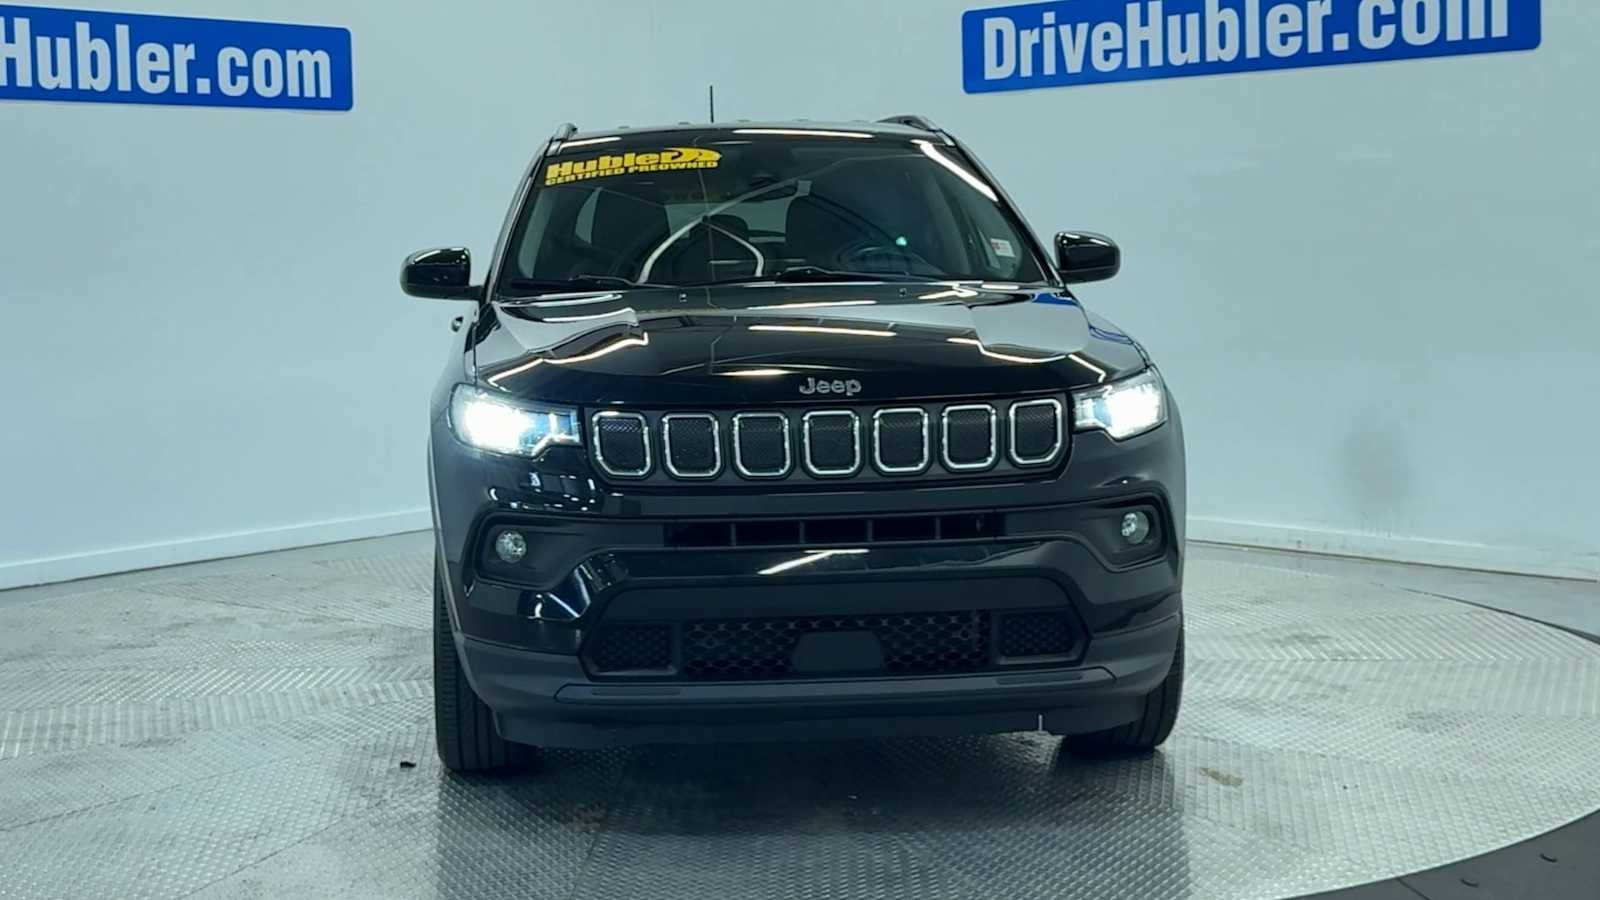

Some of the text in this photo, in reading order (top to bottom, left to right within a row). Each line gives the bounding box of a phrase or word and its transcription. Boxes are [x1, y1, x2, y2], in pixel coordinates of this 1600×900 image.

[984, 0, 1508, 80] DriveHubler.com
[545, 161, 718, 186] CERTIFIED PREOWNED
[546, 152, 684, 179] Hubler
[799, 377, 862, 396] Jeep
